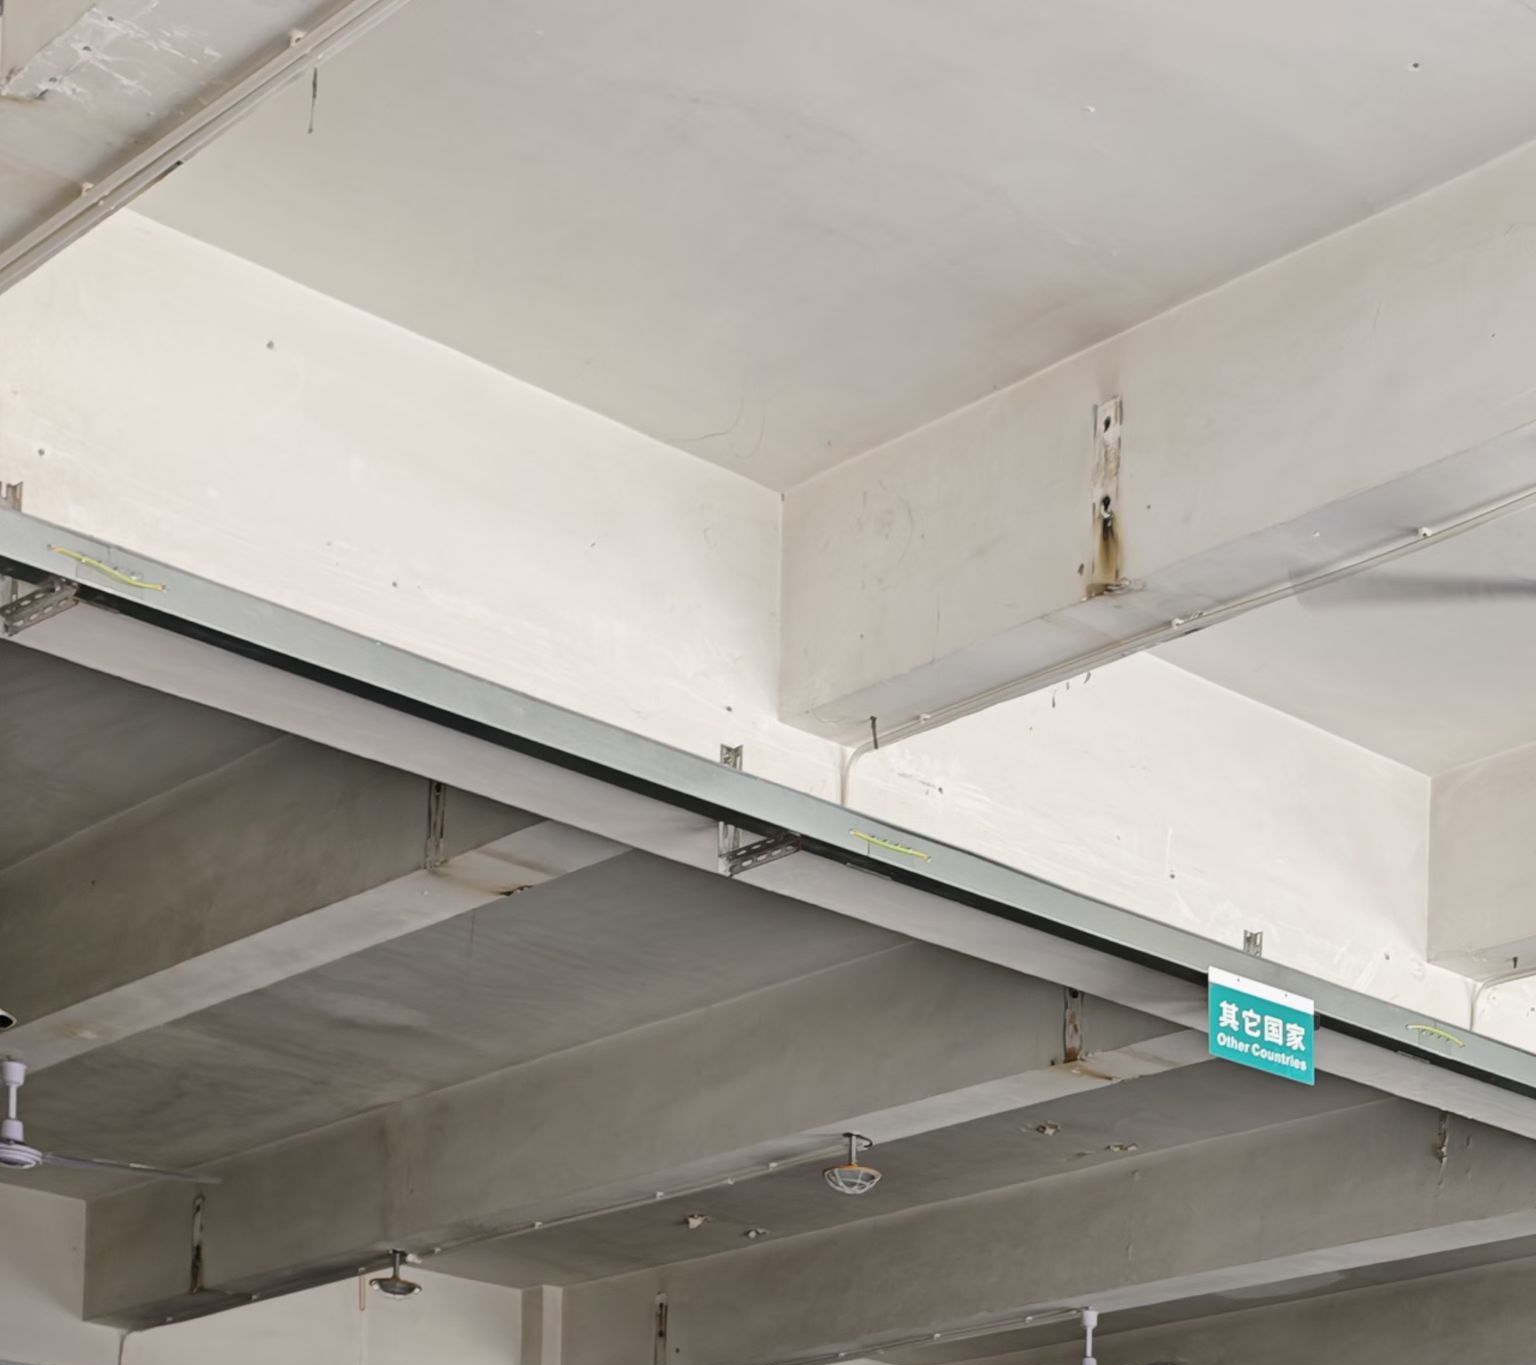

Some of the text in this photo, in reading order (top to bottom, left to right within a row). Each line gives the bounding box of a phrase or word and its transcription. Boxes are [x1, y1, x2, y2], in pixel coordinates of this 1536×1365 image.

[1218, 1000, 1306, 1052] 其它国家
[1216, 1032, 1307, 1071] Other Countries
